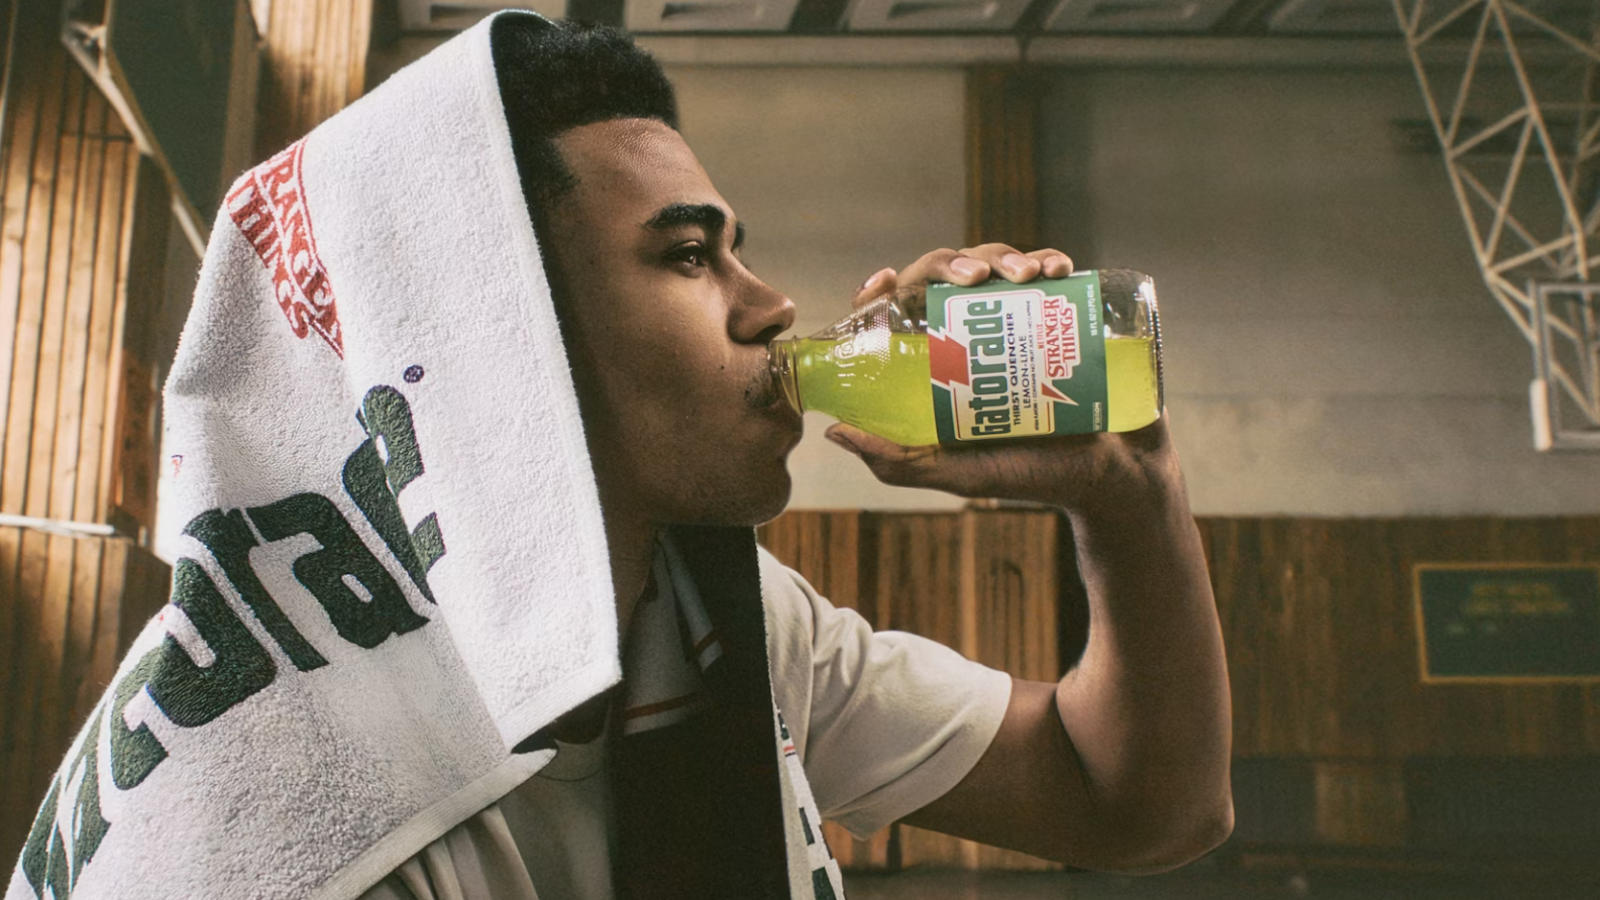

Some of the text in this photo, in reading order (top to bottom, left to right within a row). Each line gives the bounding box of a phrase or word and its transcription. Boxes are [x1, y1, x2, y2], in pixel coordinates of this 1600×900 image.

[963, 300, 1011, 436] Gatorade
[1005, 312, 1021, 426] THIRST QUENCHER
[1019, 336, 1031, 408] LEMON-LIME
[1030, 363, 1036, 373] NO
[1043, 298, 1065, 377] STRANGER
[1060, 307, 1076, 363] THINGS
